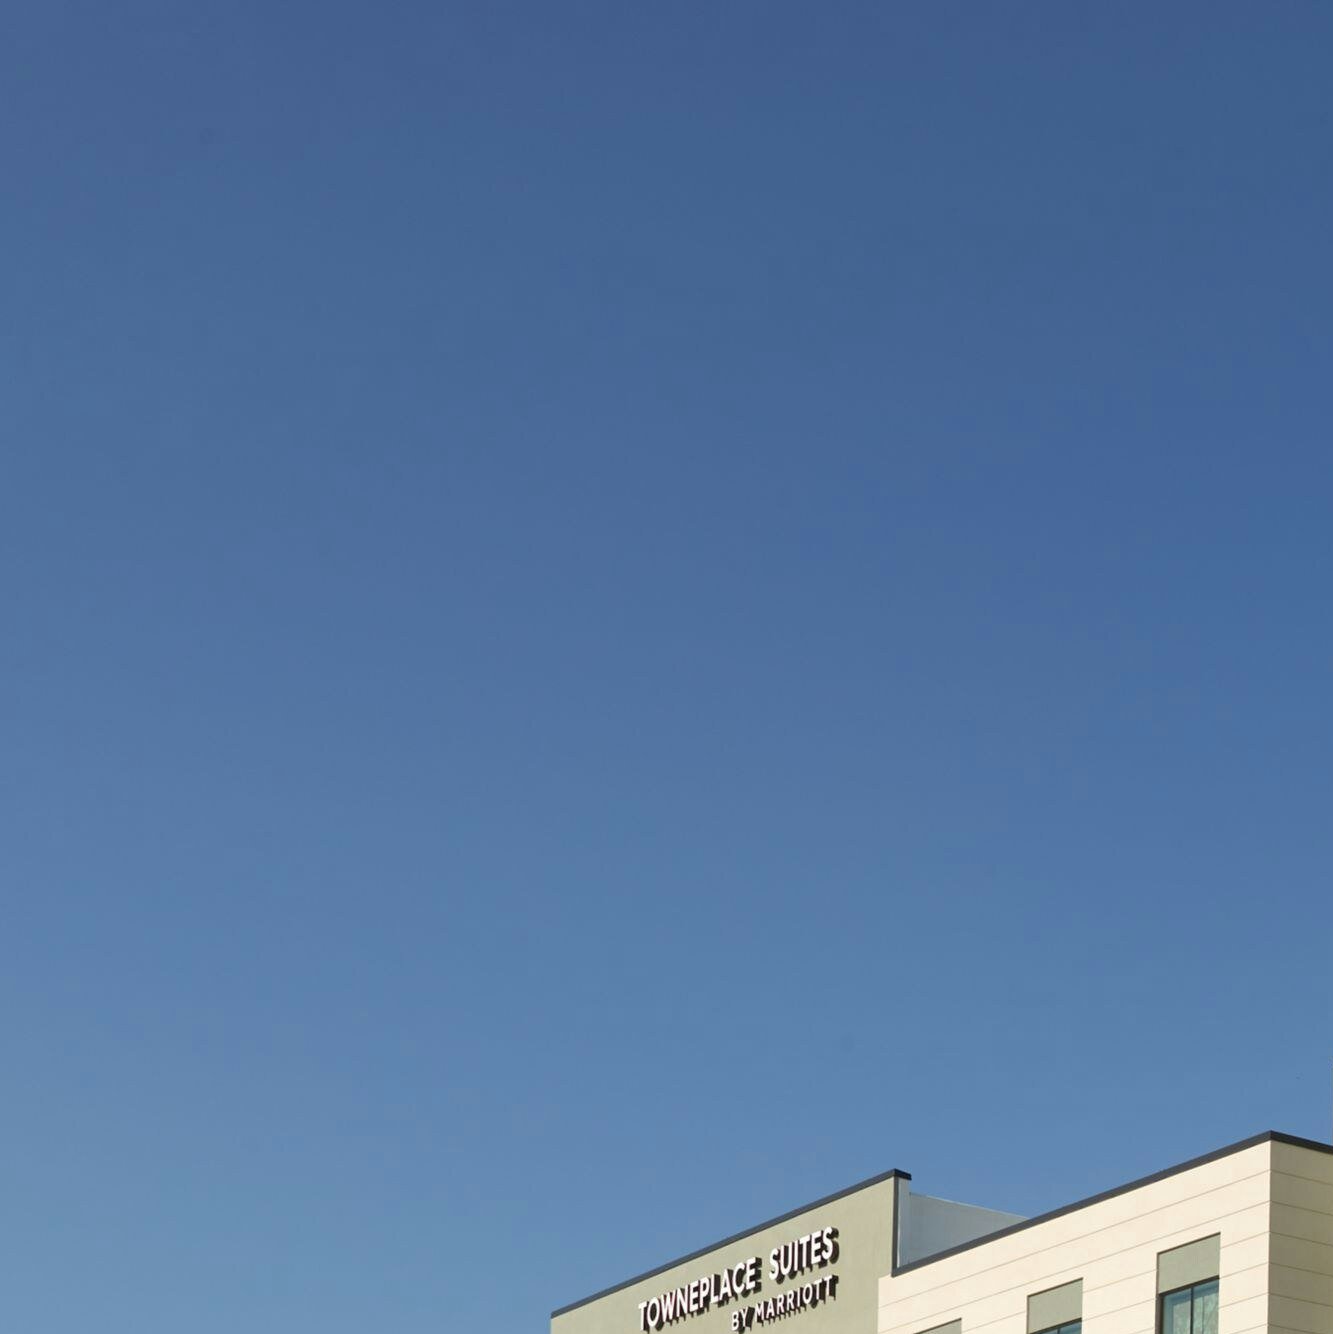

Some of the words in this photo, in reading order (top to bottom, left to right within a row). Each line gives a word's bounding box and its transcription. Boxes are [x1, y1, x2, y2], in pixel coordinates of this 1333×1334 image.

[638, 1257, 759, 1333] TOWNEPLACE
[769, 1226, 837, 1282] SUITES
[731, 1305, 752, 1333] BY
[754, 1275, 837, 1325] MARRIOTT
